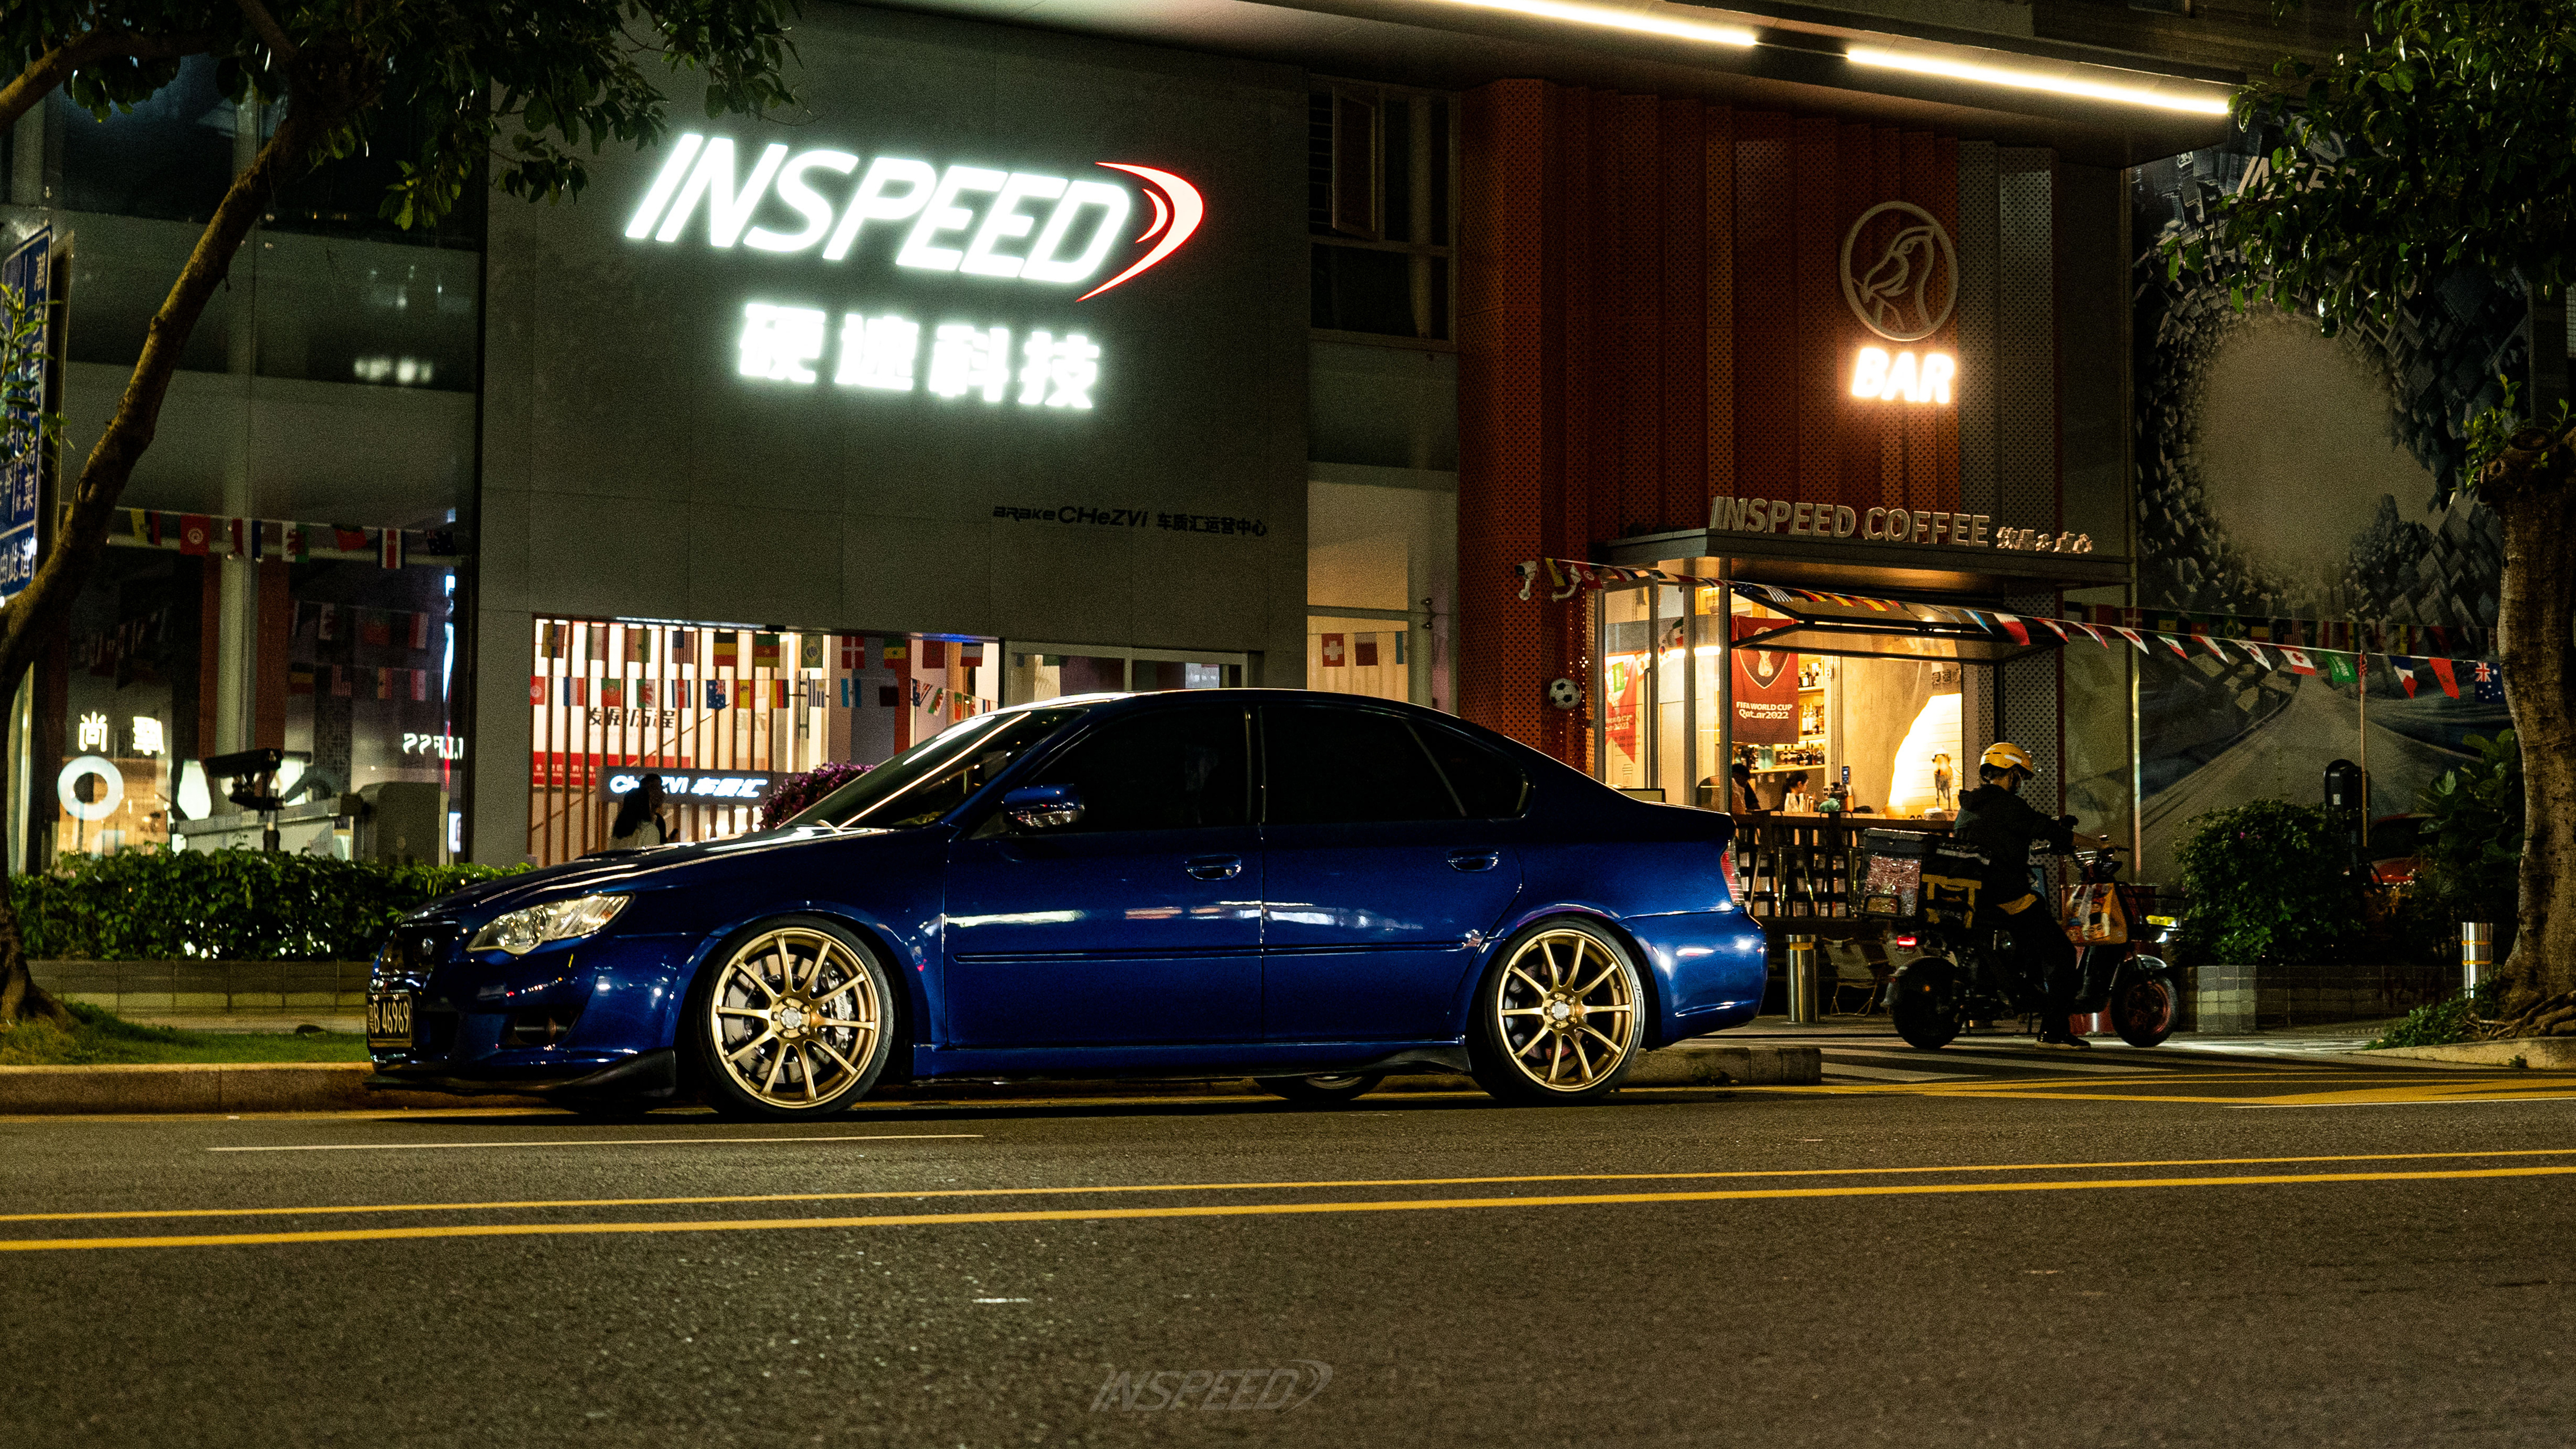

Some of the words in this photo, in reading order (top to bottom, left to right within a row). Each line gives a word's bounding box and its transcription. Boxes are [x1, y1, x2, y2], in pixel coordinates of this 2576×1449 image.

[624, 133, 1131, 284] INSPEED
[738, 303, 1099, 409] 硬速科技
[1852, 347, 1955, 404] BAR
[1157, 513, 1267, 536] 车质汇运营中心
[1709, 495, 1856, 539] INSPEED
[1861, 506, 1990, 548] COFFEE
[1736, 701, 1751, 710] FIFA
[1750, 703, 1776, 711] WORLD
[382, 1001, 409, 1034] 46969
